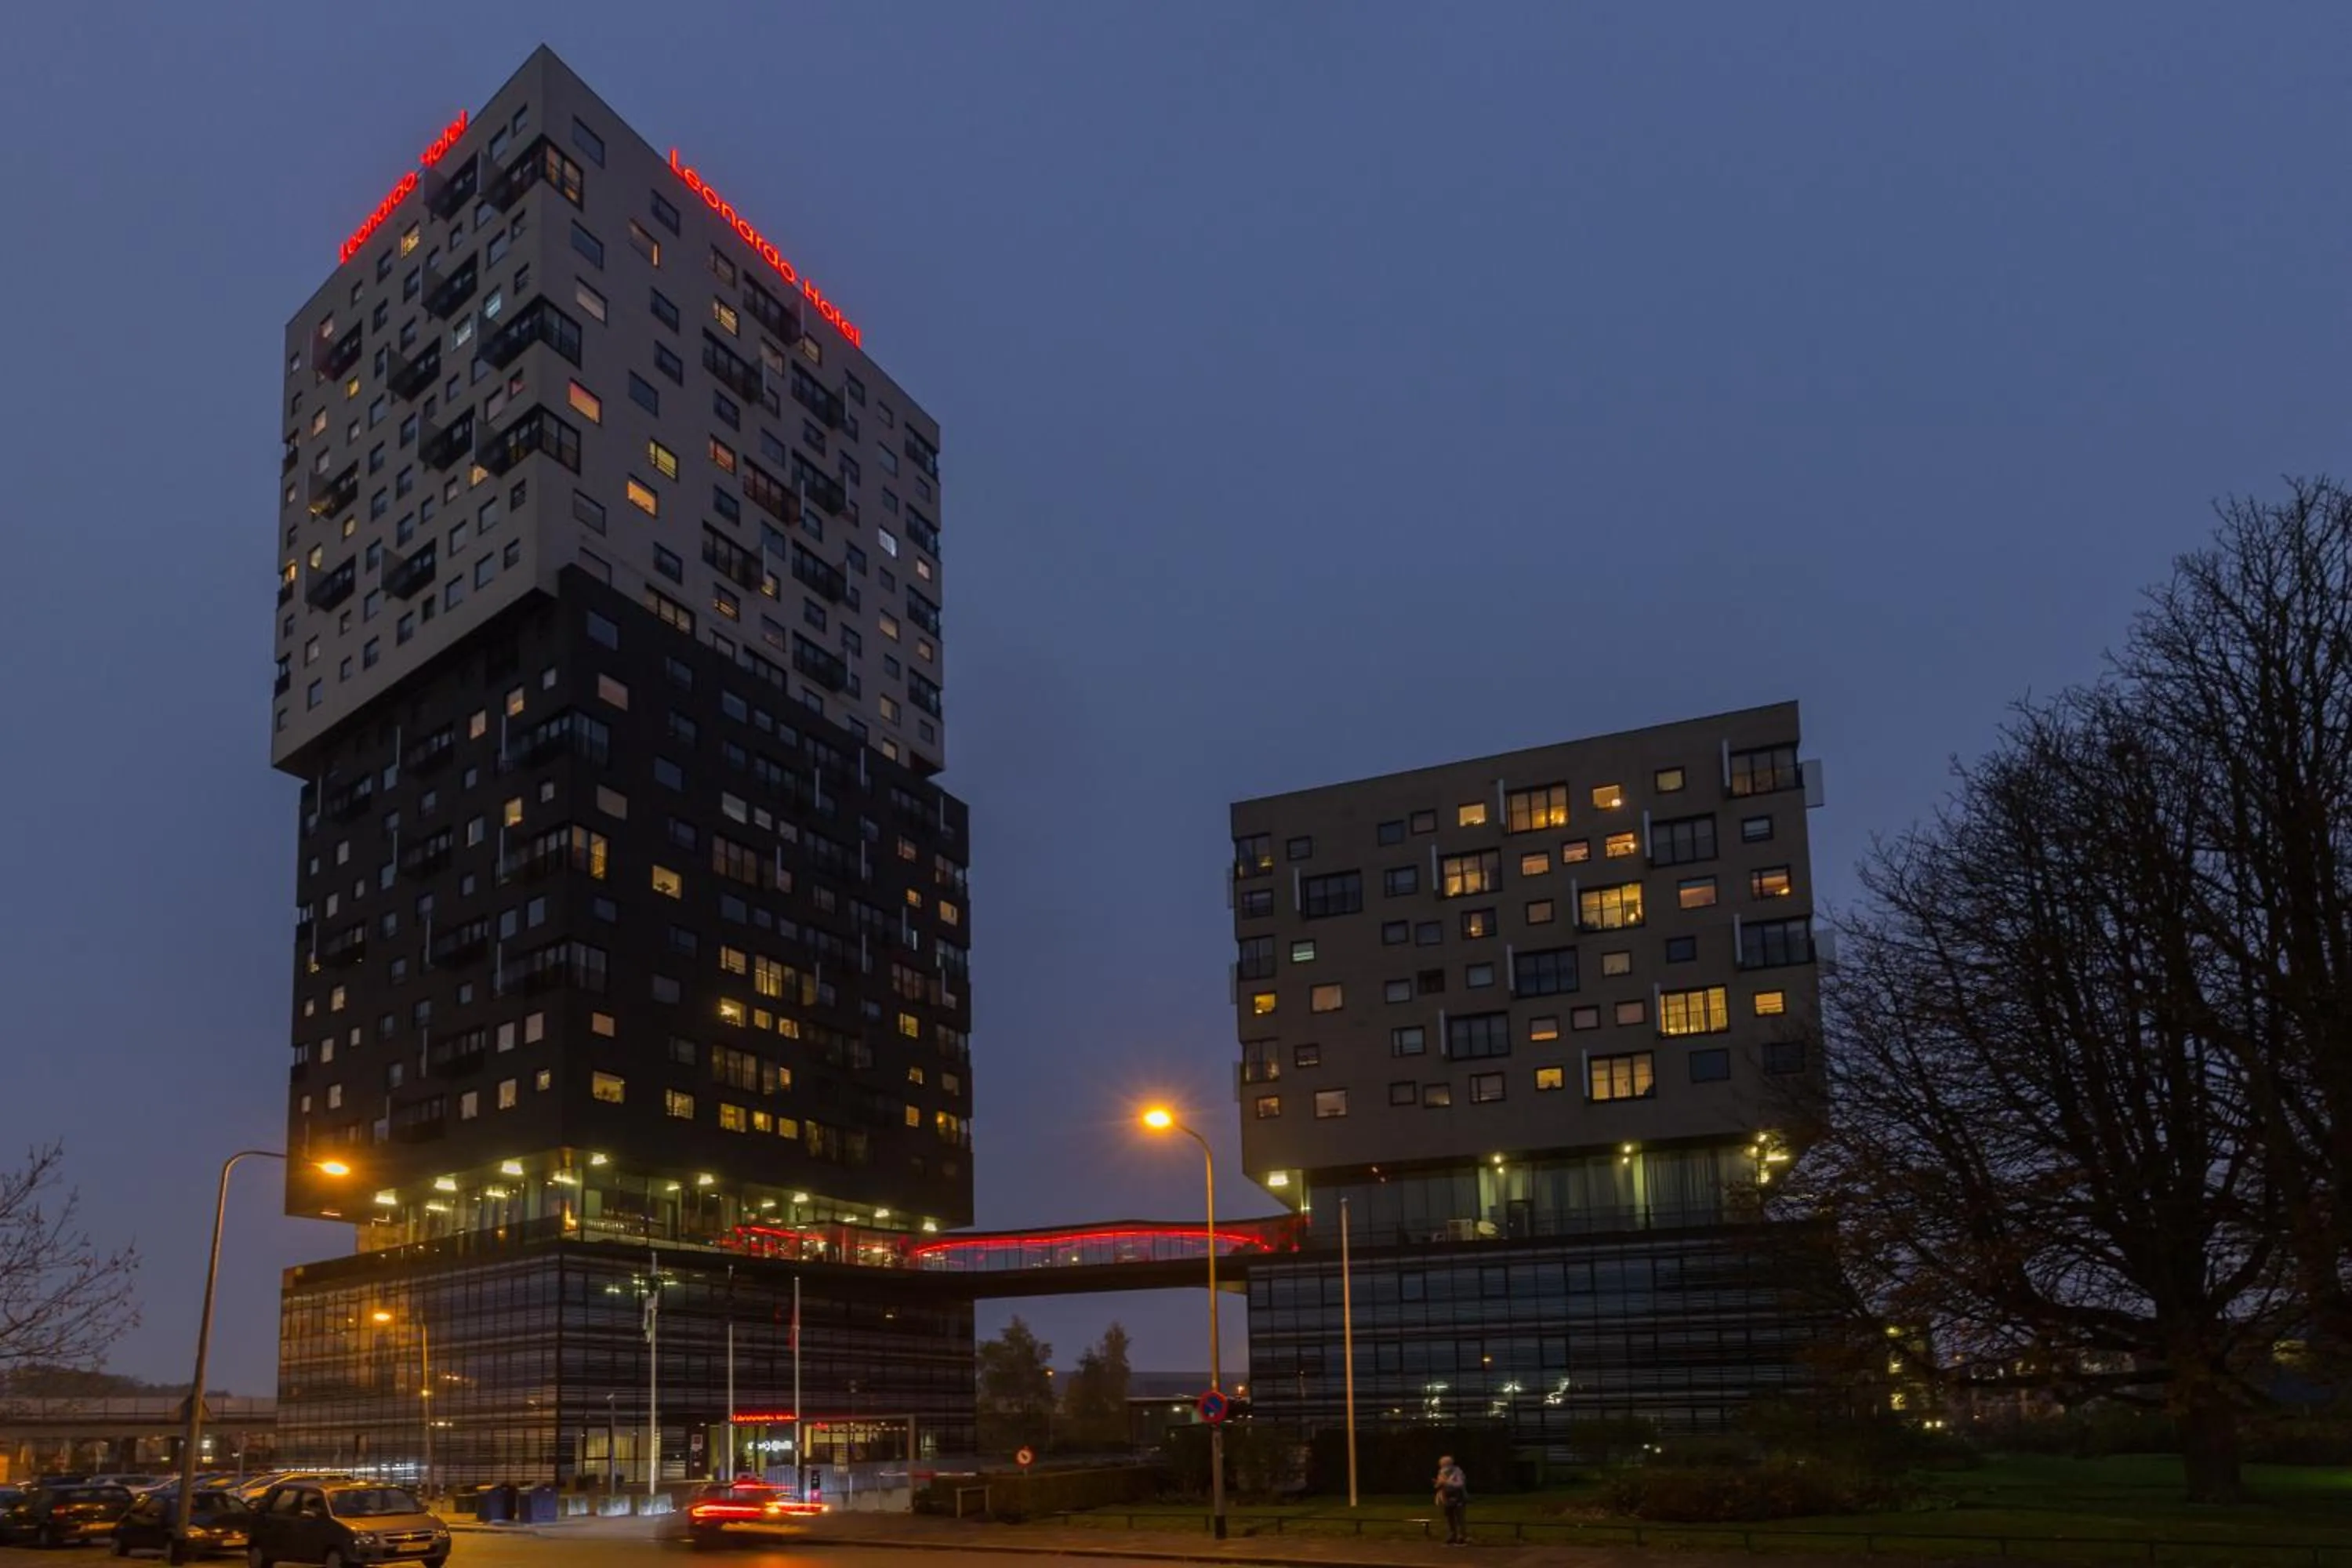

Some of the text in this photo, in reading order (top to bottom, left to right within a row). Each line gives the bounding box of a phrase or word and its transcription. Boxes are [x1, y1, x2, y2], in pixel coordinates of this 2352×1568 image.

[339, 172, 416, 263] Leonardo
[670, 149, 860, 347] Leonardo Hotel
